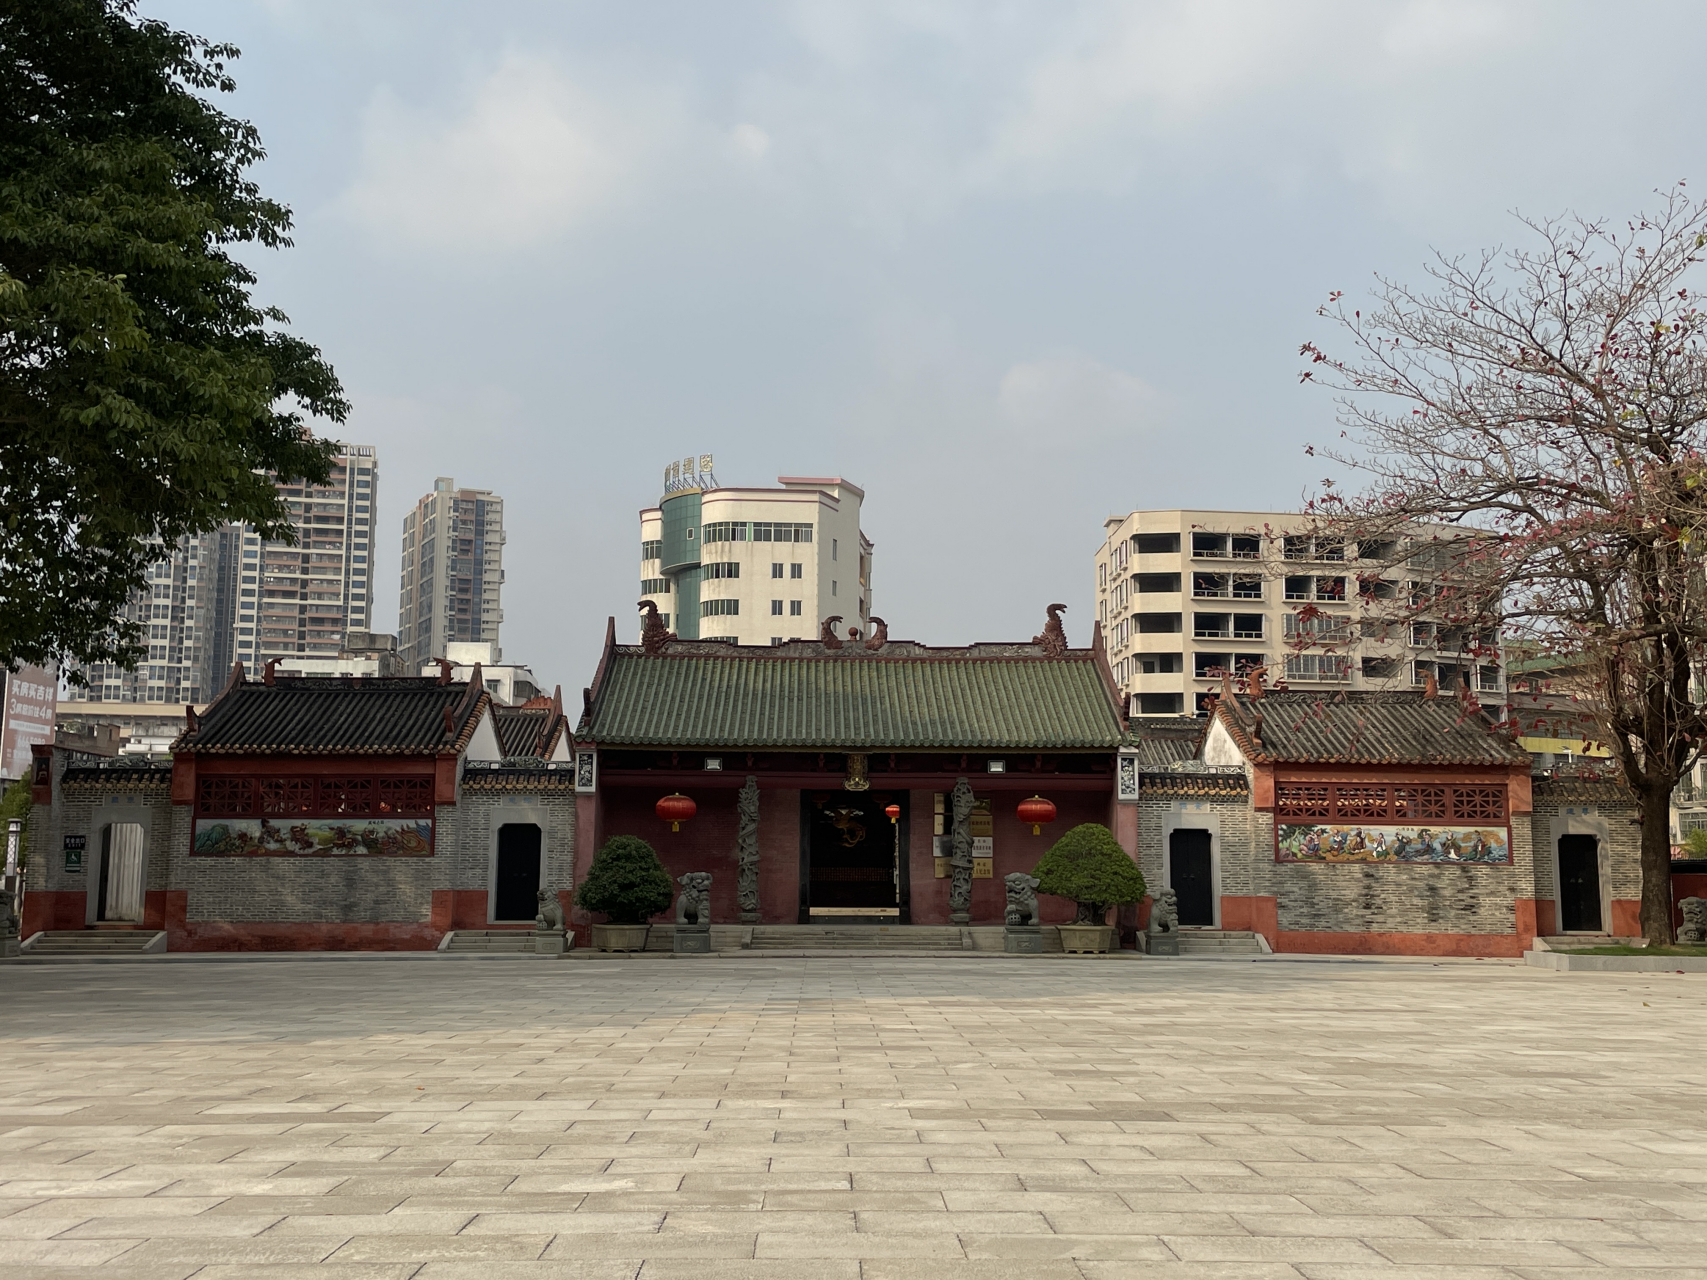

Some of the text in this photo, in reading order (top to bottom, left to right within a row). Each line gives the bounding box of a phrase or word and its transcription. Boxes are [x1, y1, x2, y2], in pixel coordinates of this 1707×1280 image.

[12, 679, 54, 702] 买房买吉祥
